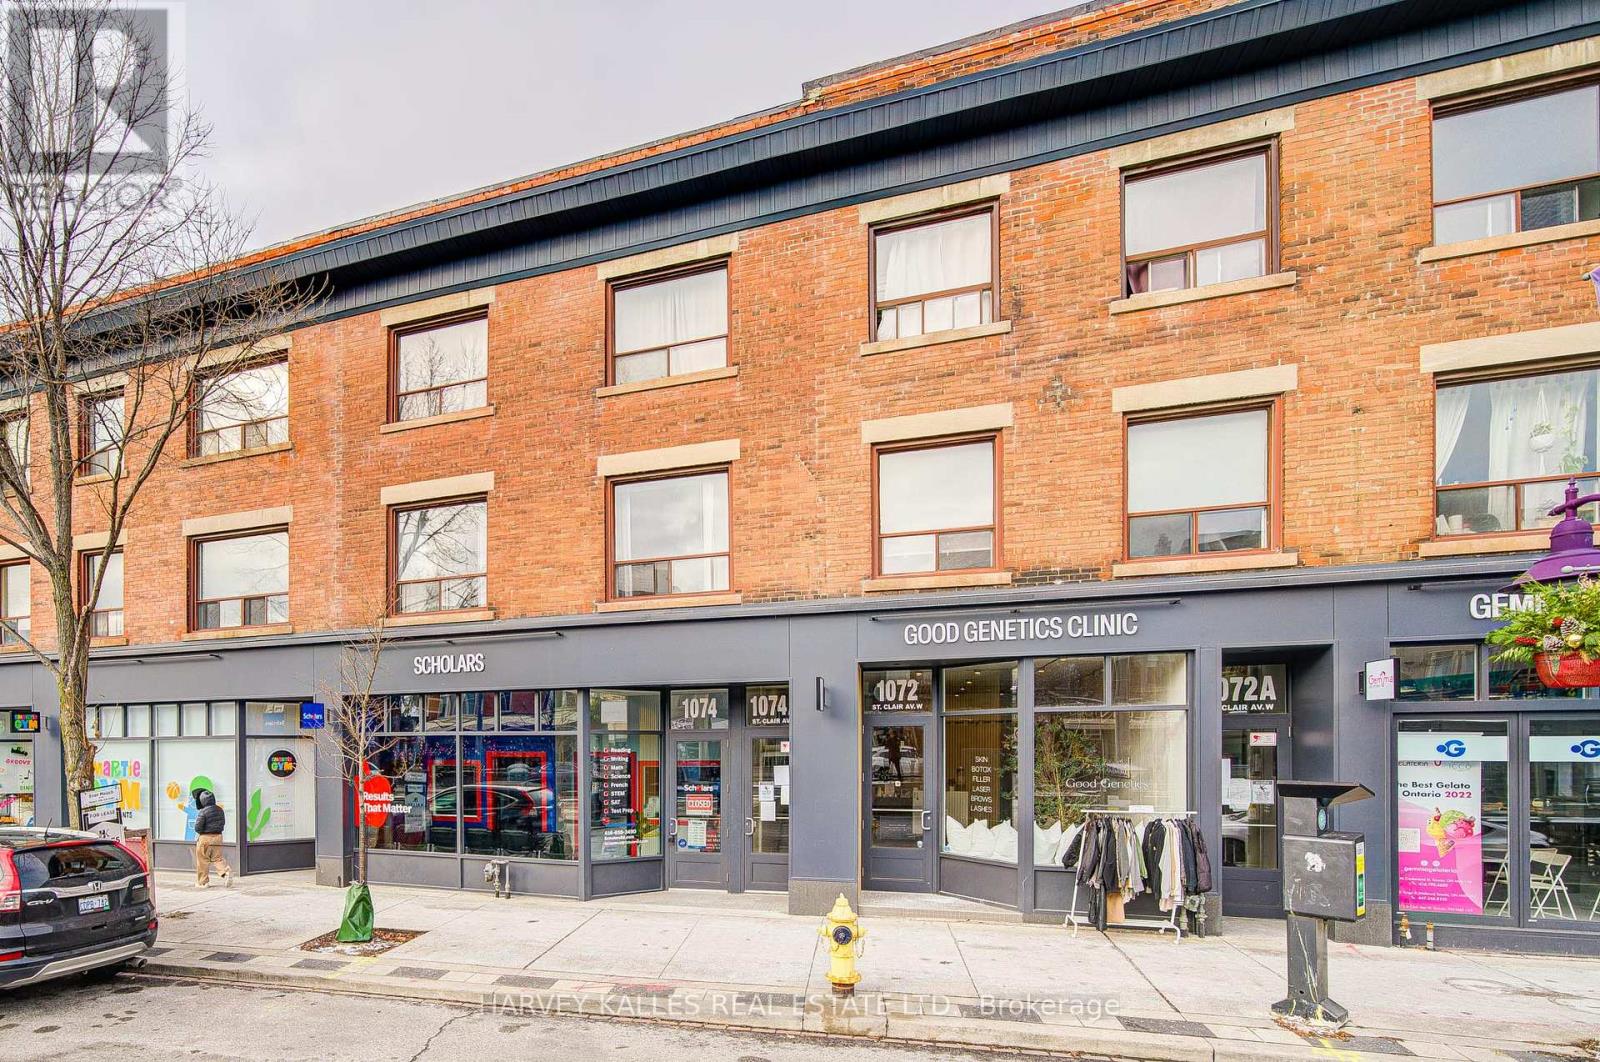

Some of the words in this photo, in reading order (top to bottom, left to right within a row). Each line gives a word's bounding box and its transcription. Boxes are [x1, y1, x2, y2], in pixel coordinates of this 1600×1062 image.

[1470, 594, 1546, 619] GEM
[904, 624, 959, 645] GOOD
[964, 617, 1063, 642] GENETICS
[1067, 613, 1138, 638] CLINIC
[413, 653, 485, 674] SCHOLARS
[877, 680, 918, 701] 1072
[1221, 676, 1276, 701] 072A
[682, 698, 717, 718] 1074
[750, 695, 789, 717] 1074
[15, 720, 38, 729] GYM
[271, 762, 293, 771] GYM
[1065, 778, 1096, 789] Good
[363, 792, 394, 801] Results
[688, 800, 711, 808] CLOSED
[364, 803, 381, 813] That
[383, 803, 412, 813] Matter
[971, 805, 992, 813] LASHES
